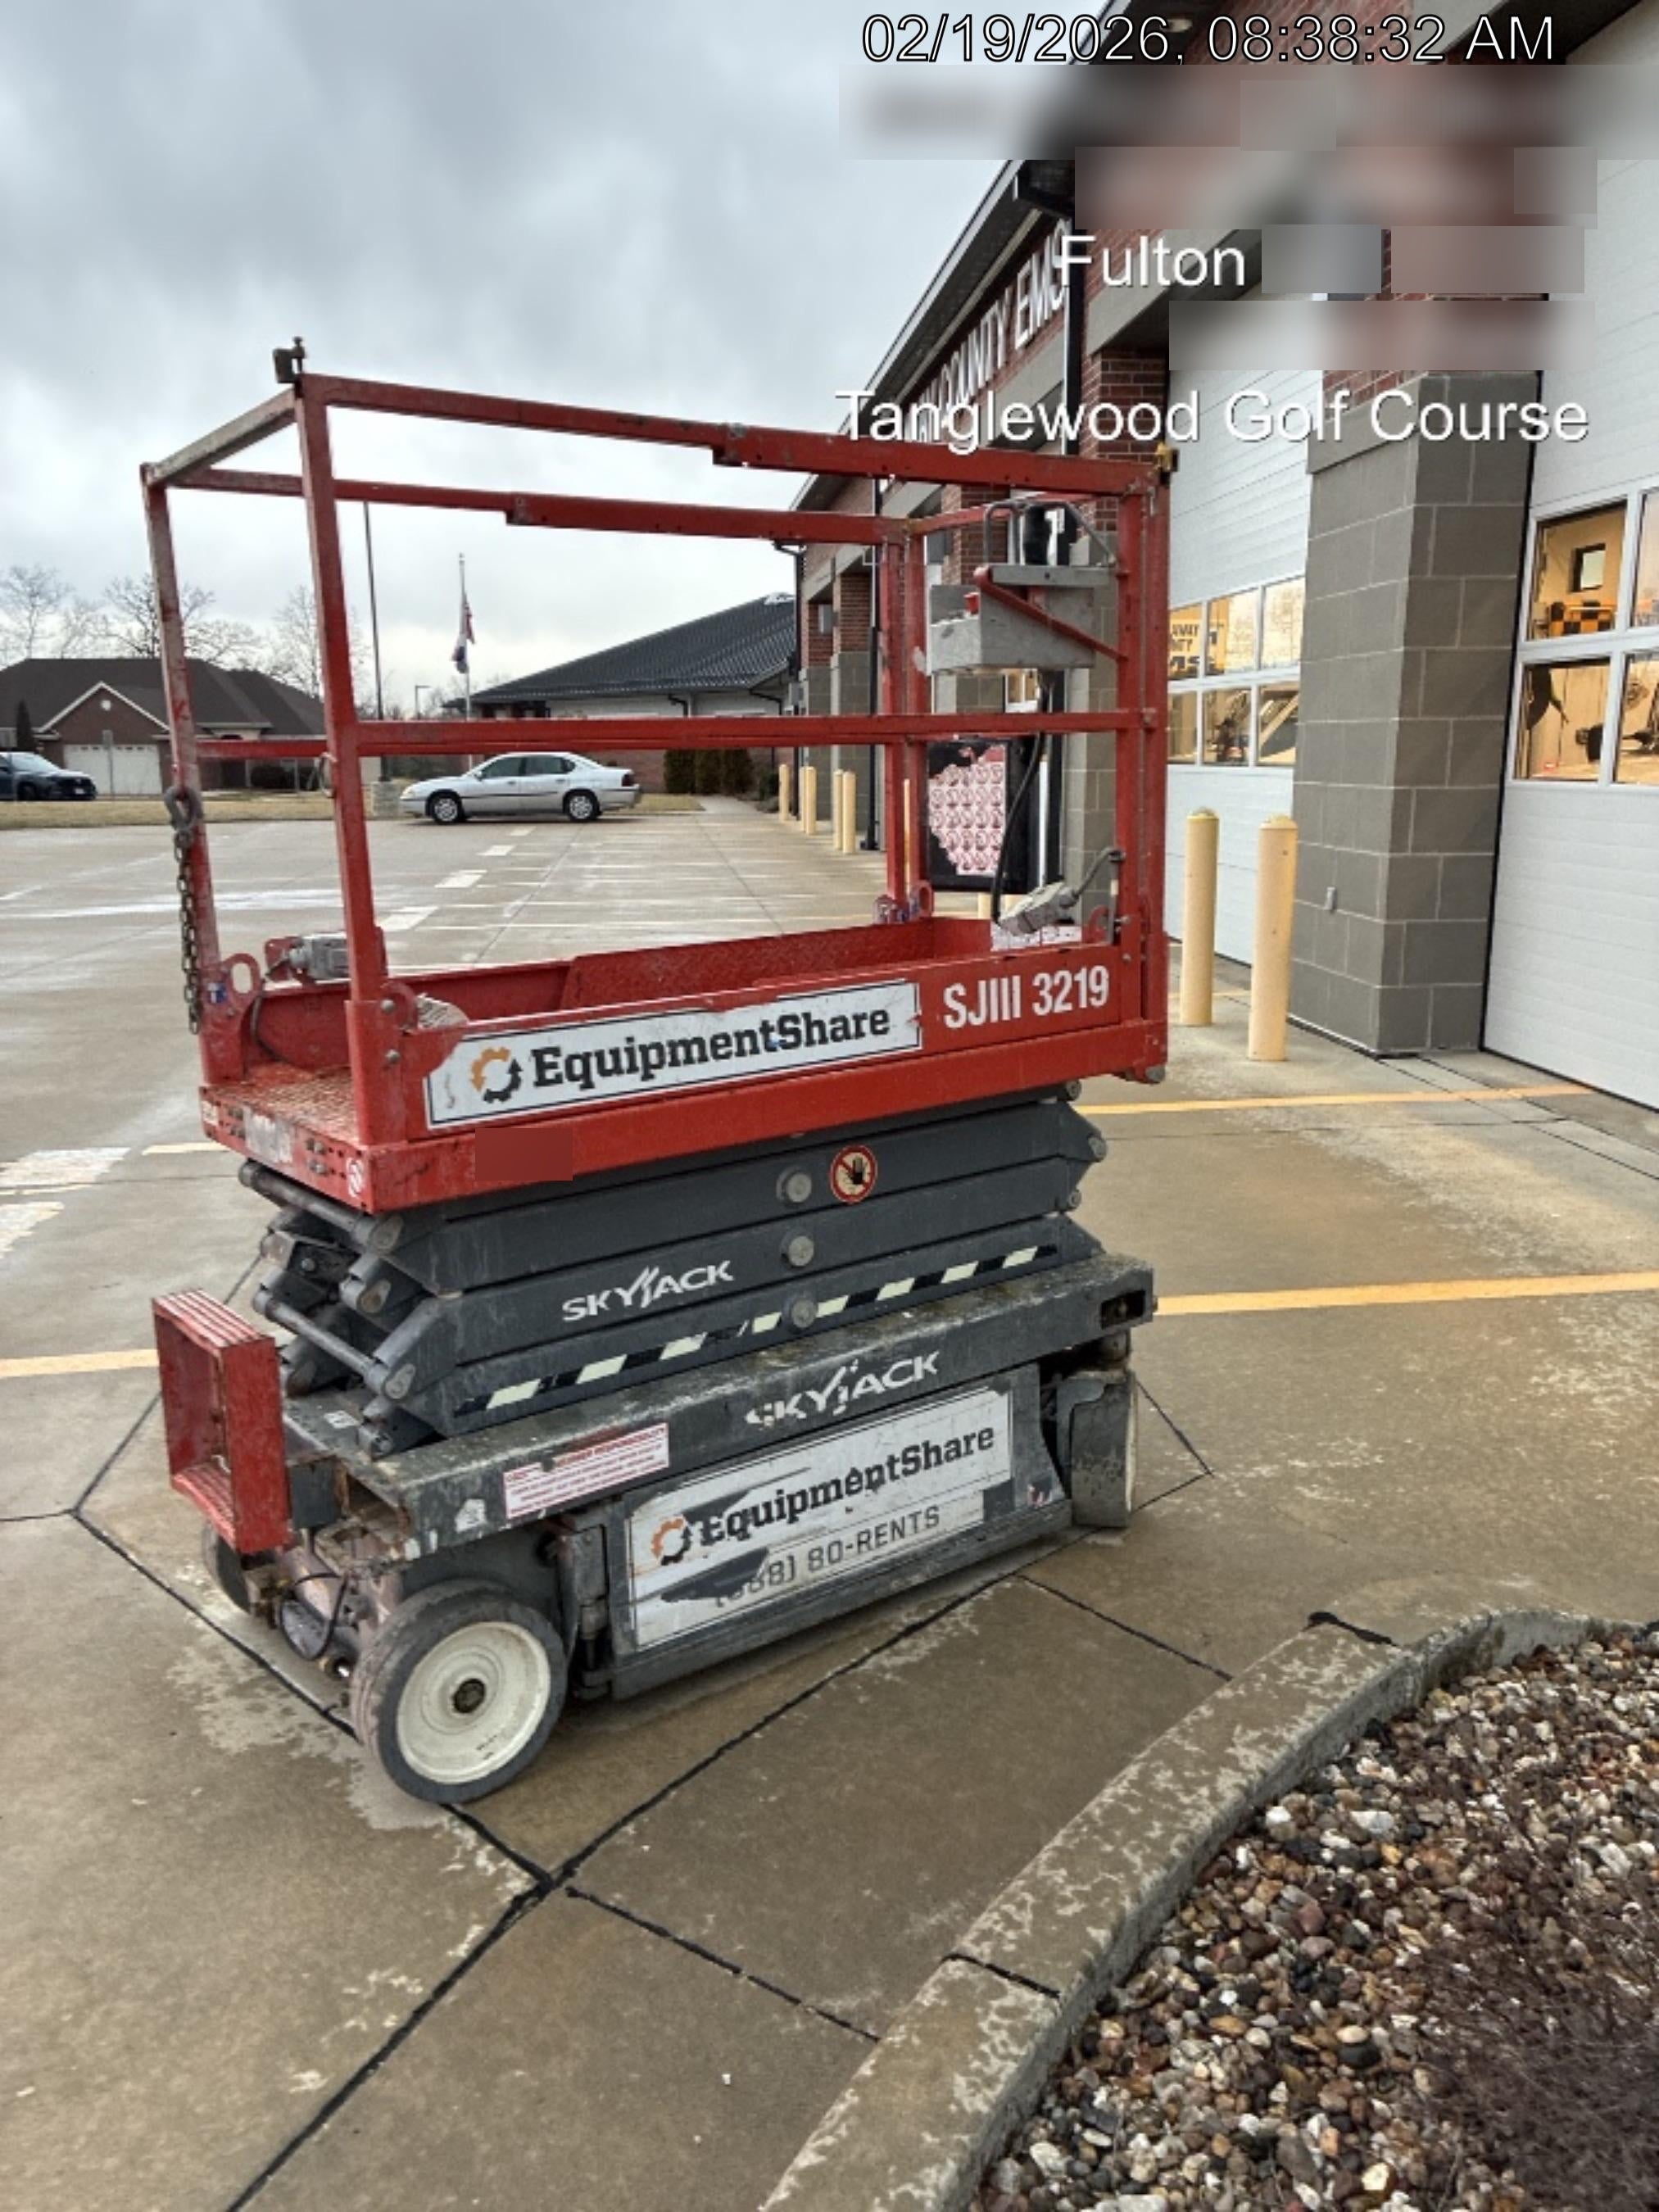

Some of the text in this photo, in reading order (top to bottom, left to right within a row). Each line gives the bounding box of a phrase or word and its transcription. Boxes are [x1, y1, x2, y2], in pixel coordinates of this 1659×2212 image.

[944, 965, 1109, 1029] SJIII 3219
[530, 1009, 891, 1090] EquipmentShare
[561, 1260, 735, 1321] SKYJACK
[700, 1426, 995, 1546] EquipmentShare
[807, 1505, 940, 1573] 80-RENTS
